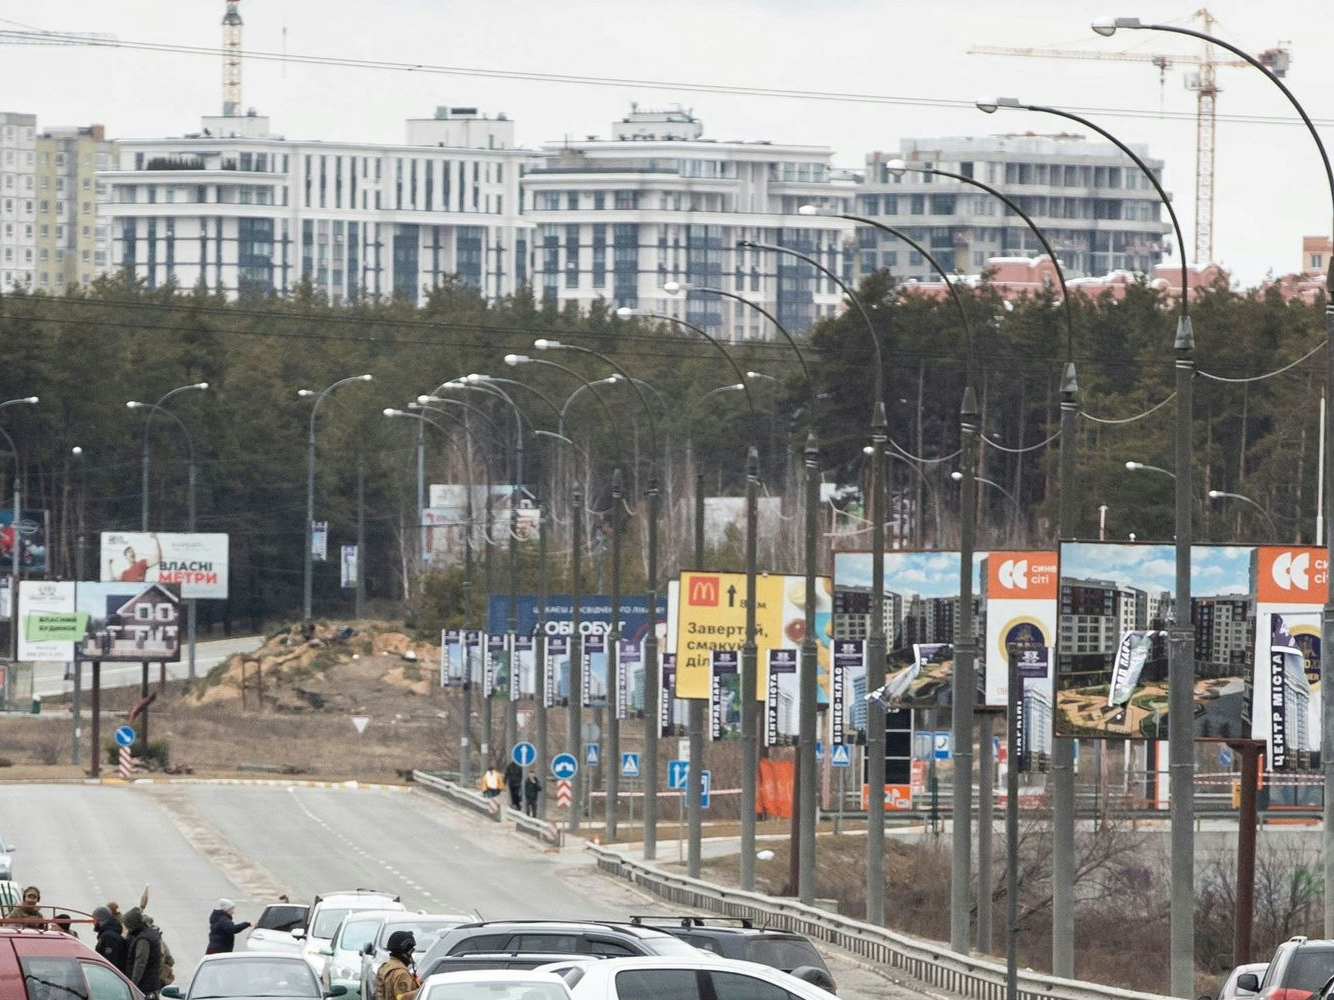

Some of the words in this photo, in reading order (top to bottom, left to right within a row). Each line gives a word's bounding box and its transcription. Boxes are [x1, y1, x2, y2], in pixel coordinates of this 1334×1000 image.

[159, 561, 213, 571] ВЛАСНІ
[158, 572, 218, 584] МЕТРИ
[687, 622, 768, 637] Завертй,
[1272, 654, 1283, 709] МІСТА
[1273, 715, 1284, 767] ЦЕНТР
